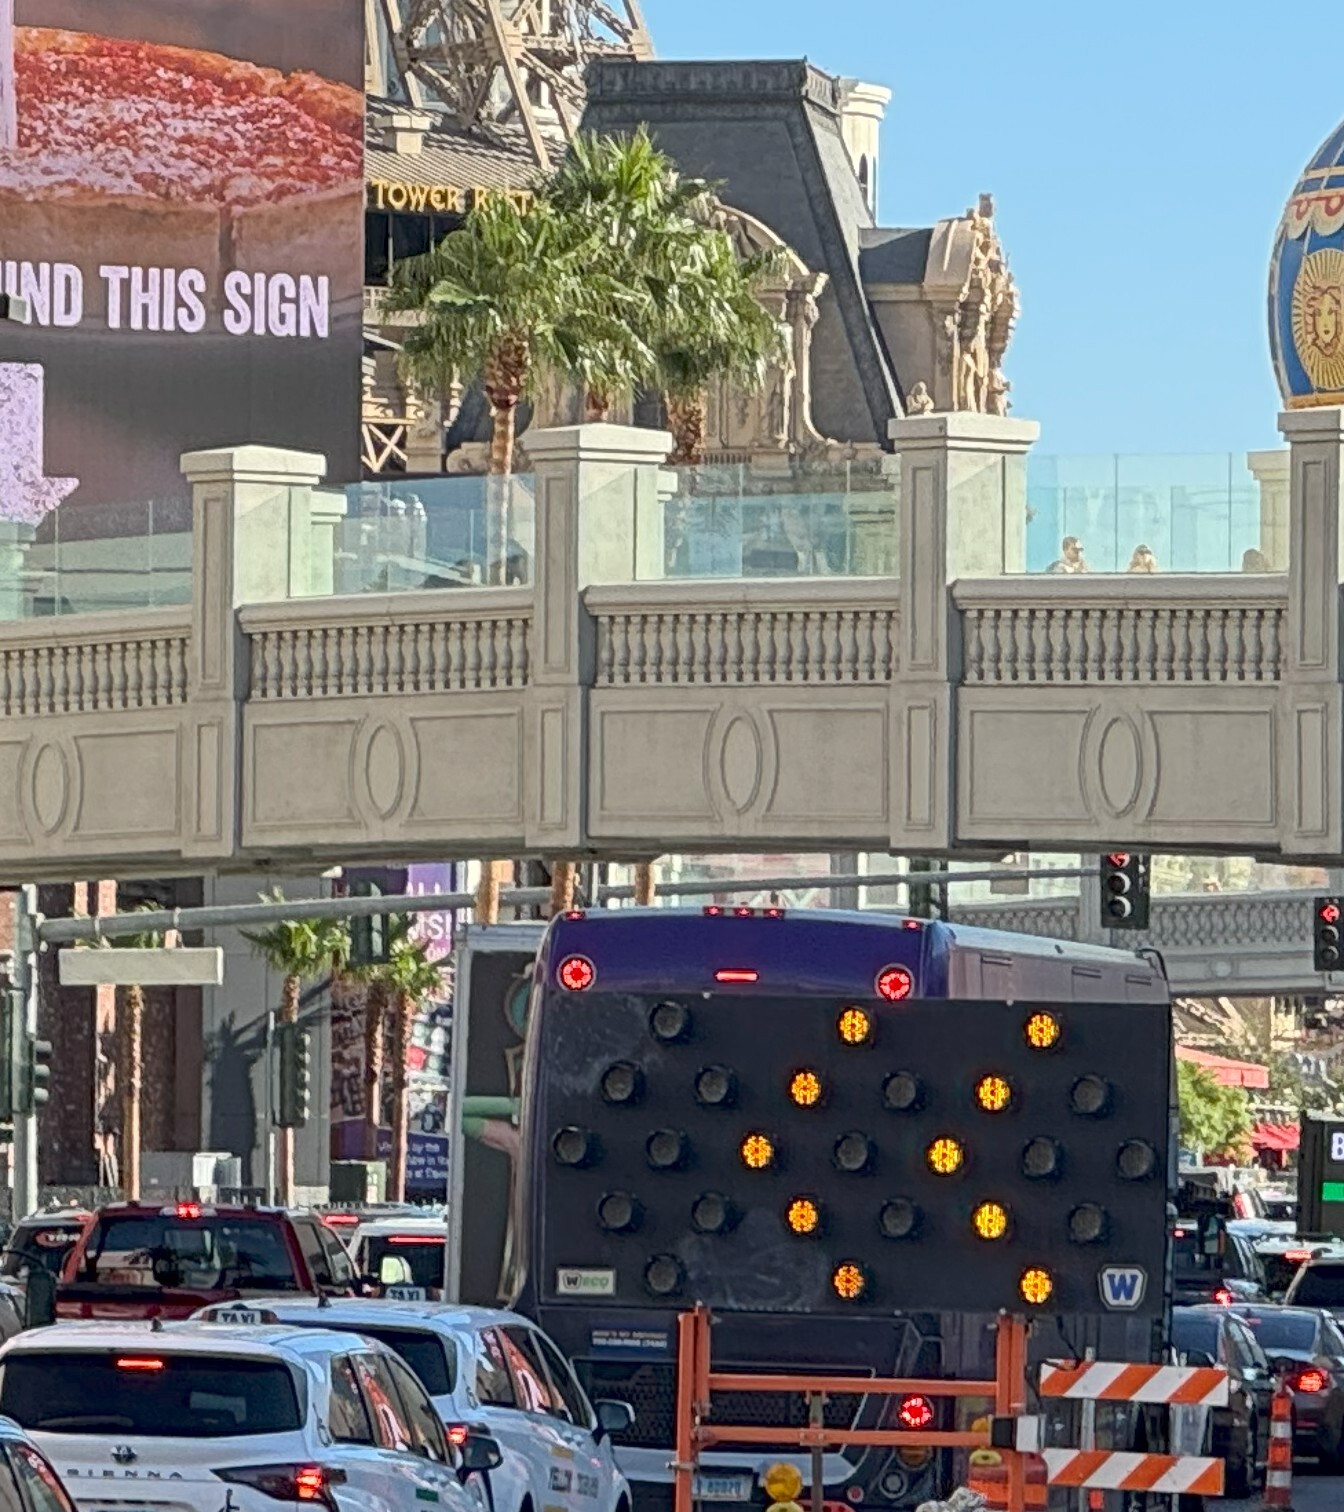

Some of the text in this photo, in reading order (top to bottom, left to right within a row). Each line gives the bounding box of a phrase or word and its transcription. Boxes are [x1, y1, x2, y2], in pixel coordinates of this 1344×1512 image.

[371, 178, 465, 214] TOWER
[99, 265, 206, 334] THIS
[223, 270, 329, 338] SIGN
[1106, 1273, 1139, 1301] W
[222, 1312, 256, 1324] TAXI
[66, 1468, 173, 1480] SIENNA
